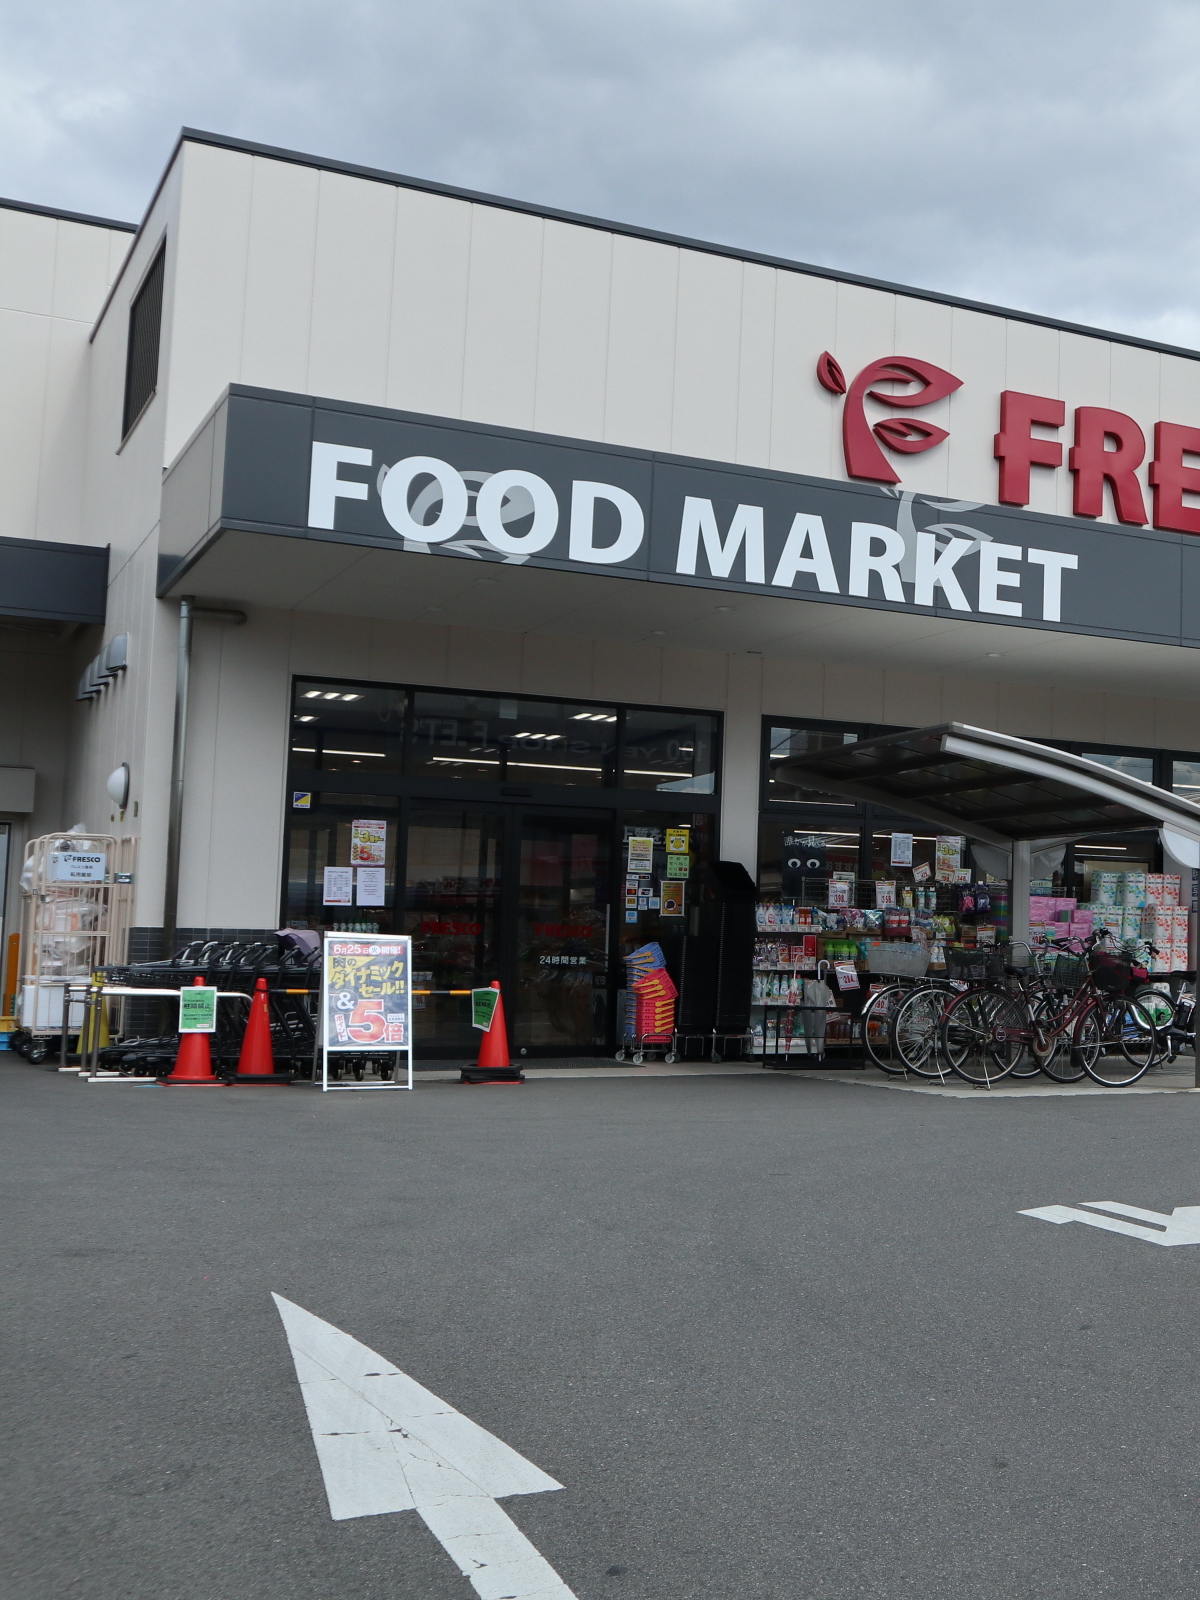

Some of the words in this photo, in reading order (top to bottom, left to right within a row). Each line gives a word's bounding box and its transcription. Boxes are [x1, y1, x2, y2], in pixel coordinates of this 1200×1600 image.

[306, 440, 645, 566] FOOD
[674, 495, 1079, 624] MARKET
[420, 921, 482, 936] FRESCO
[534, 923, 593, 938] FRESCO
[333, 957, 357, 969] 肉の
[538, 955, 588, 966] 24時間営業
[331, 960, 404, 989] ダイナミック
